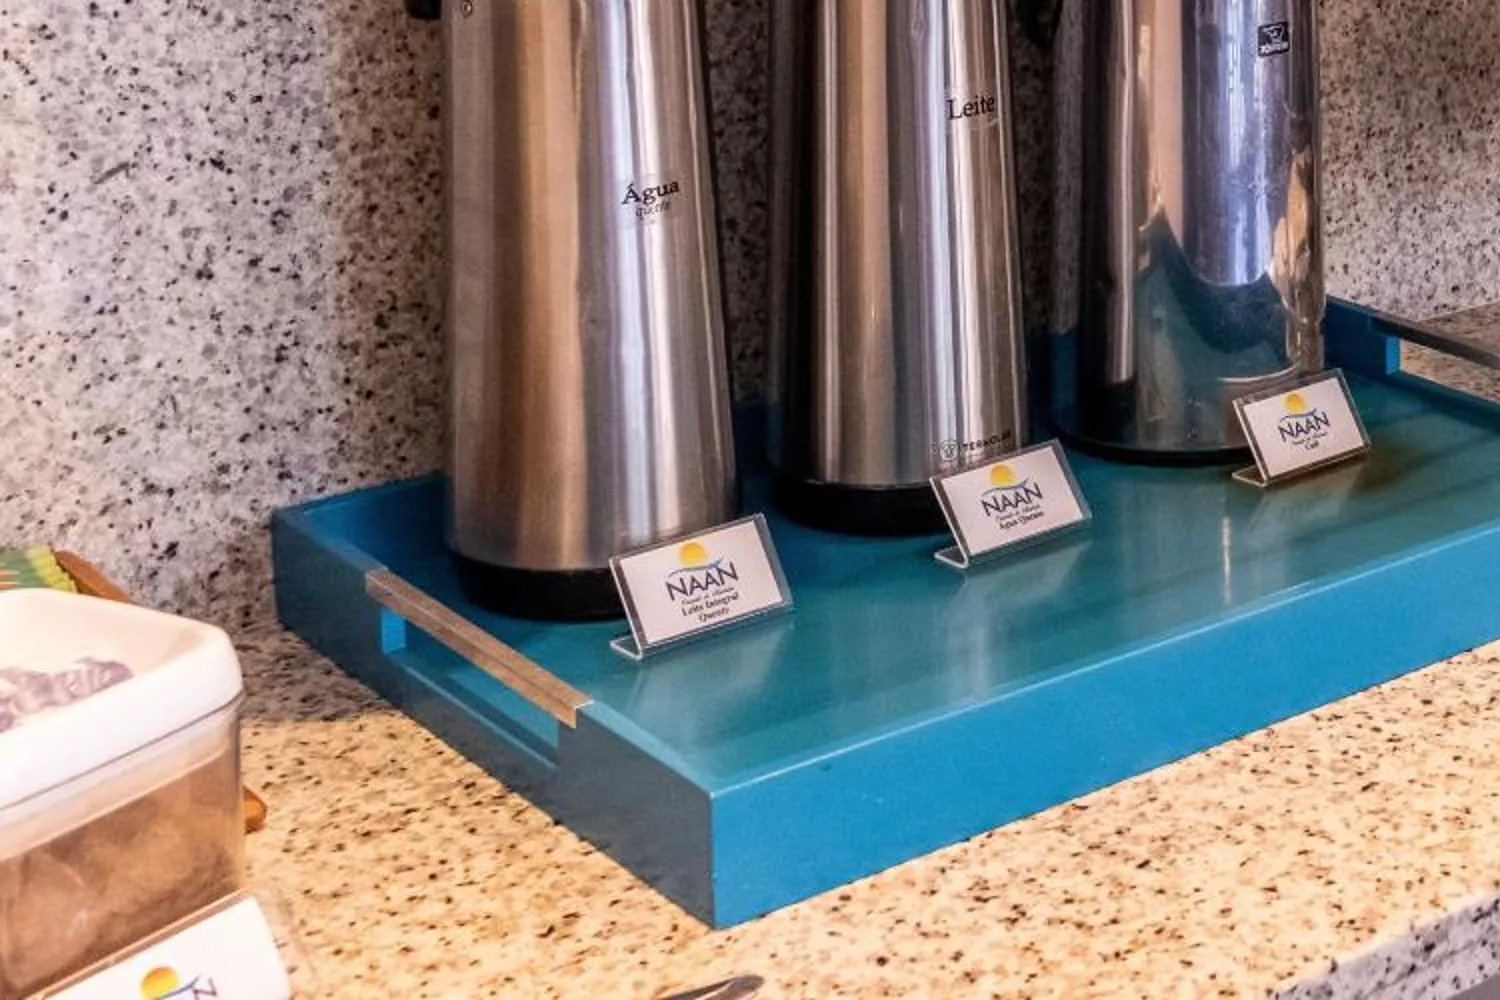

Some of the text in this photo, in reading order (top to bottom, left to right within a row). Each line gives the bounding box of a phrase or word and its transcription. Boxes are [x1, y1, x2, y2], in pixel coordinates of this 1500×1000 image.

[945, 95, 995, 120] Leite
[621, 181, 680, 206] Água
[1277, 411, 1331, 442] NAAN
[980, 482, 1044, 517] NAAN
[665, 561, 739, 601] NAAN
